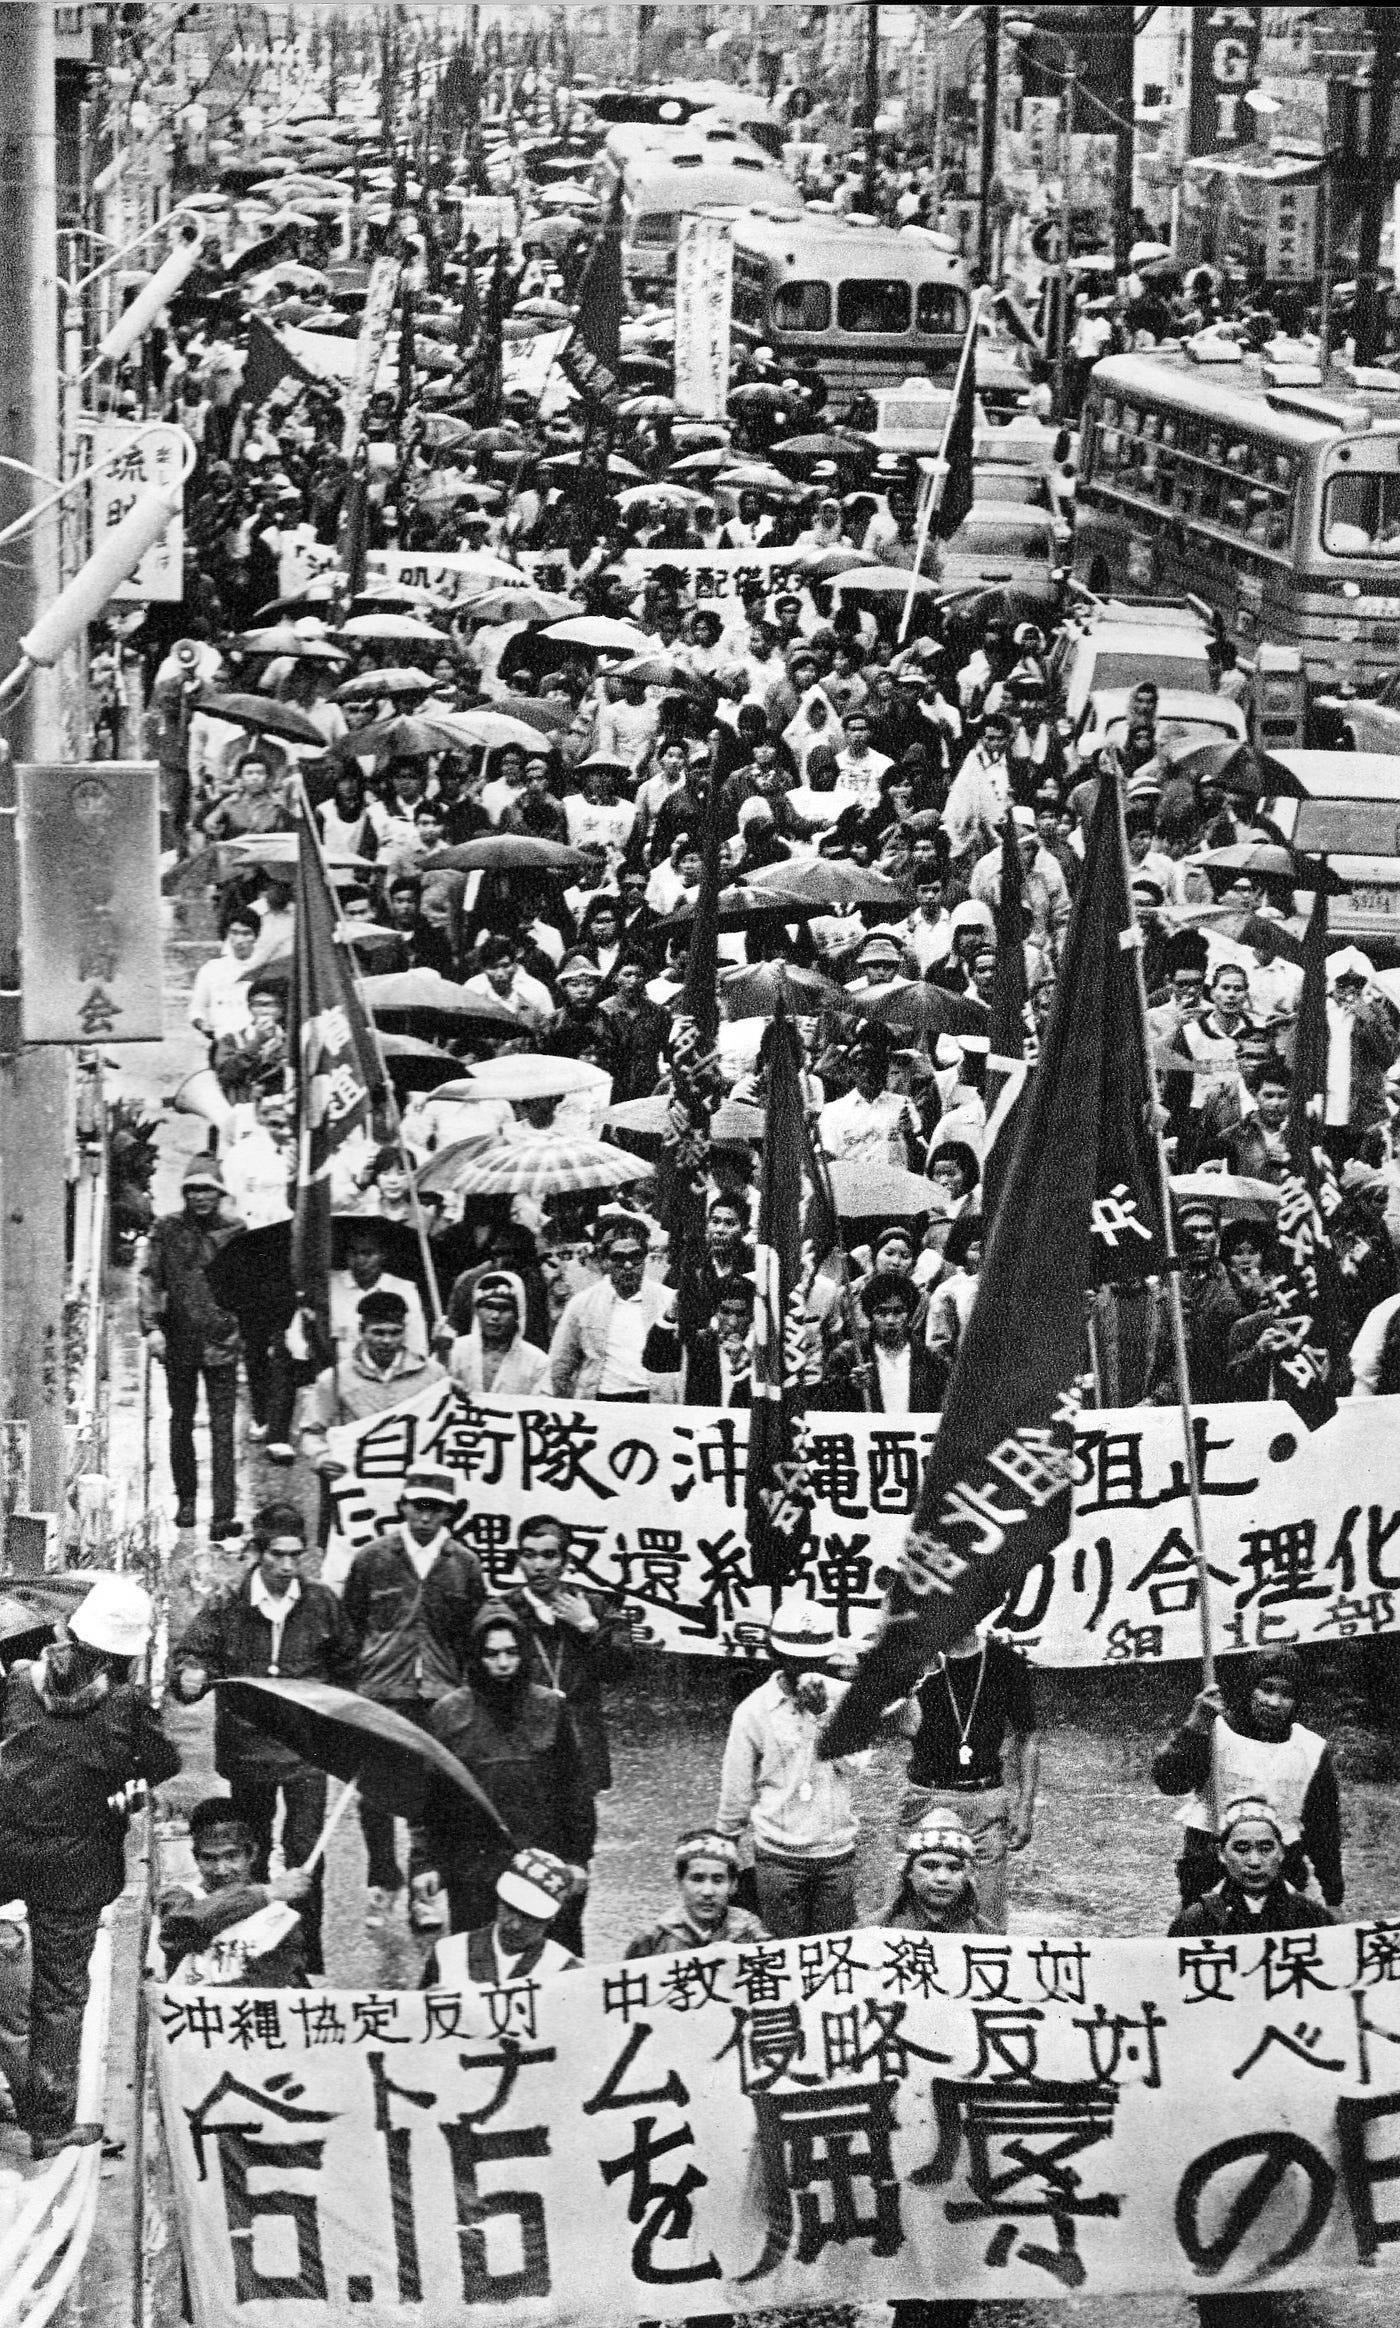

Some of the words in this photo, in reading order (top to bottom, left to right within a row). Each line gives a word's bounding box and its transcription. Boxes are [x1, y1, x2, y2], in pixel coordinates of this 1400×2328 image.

[163, 1978, 542, 2049] 沖縄協定反対
[603, 1933, 1092, 2024] 中教審路線反対
